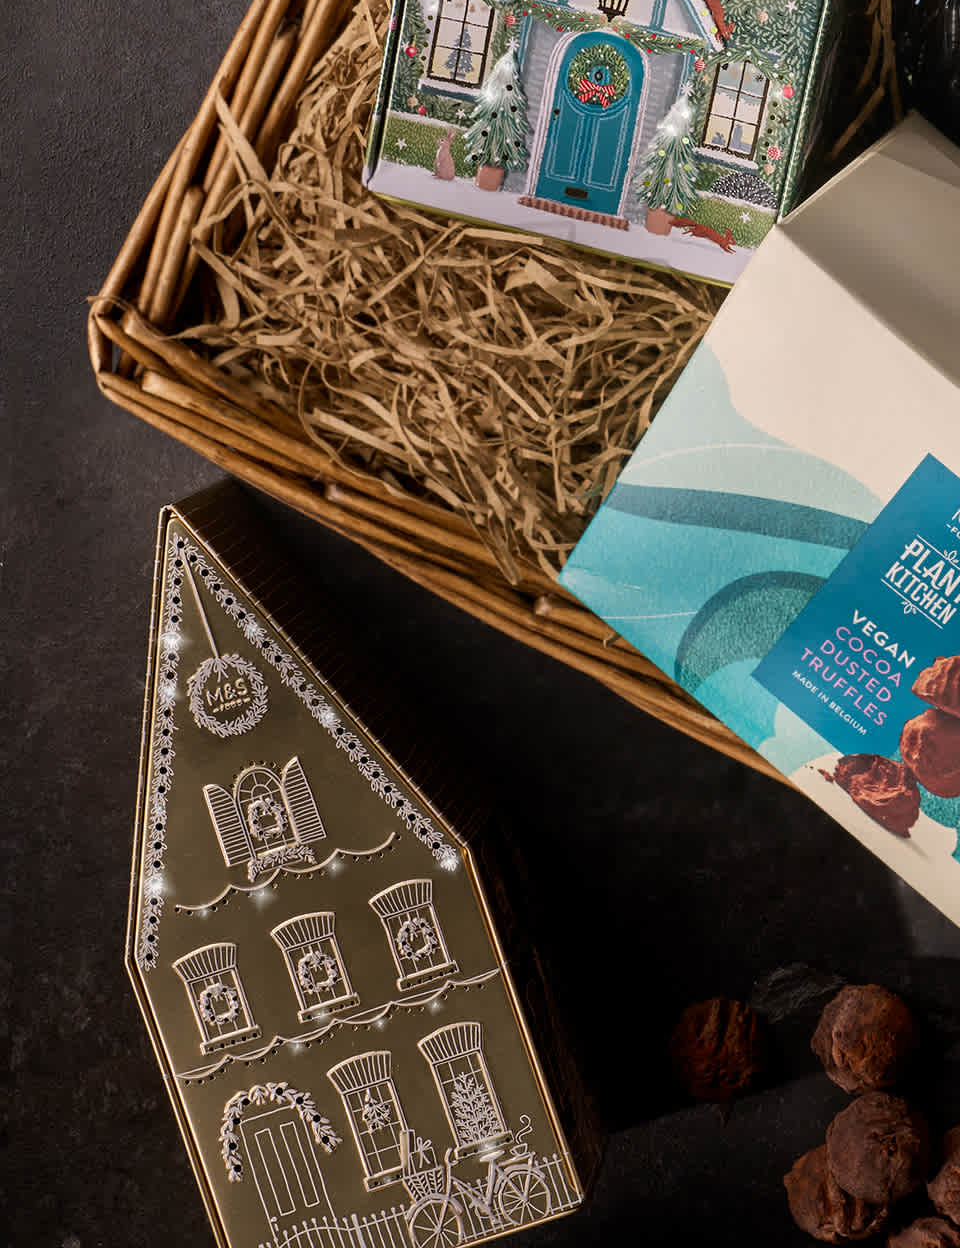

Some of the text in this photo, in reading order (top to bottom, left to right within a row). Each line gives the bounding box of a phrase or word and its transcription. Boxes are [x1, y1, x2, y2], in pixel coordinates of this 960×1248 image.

[885, 561, 957, 625] KITCHEN
[835, 626, 901, 687] COCOA
[852, 609, 916, 668] VEGAN
[206, 678, 248, 706] M&S
[792, 669, 867, 735] MADE IN BELGIUM
[800, 647, 888, 726] TRUFFLES
[819, 639, 892, 702] DUSTED
